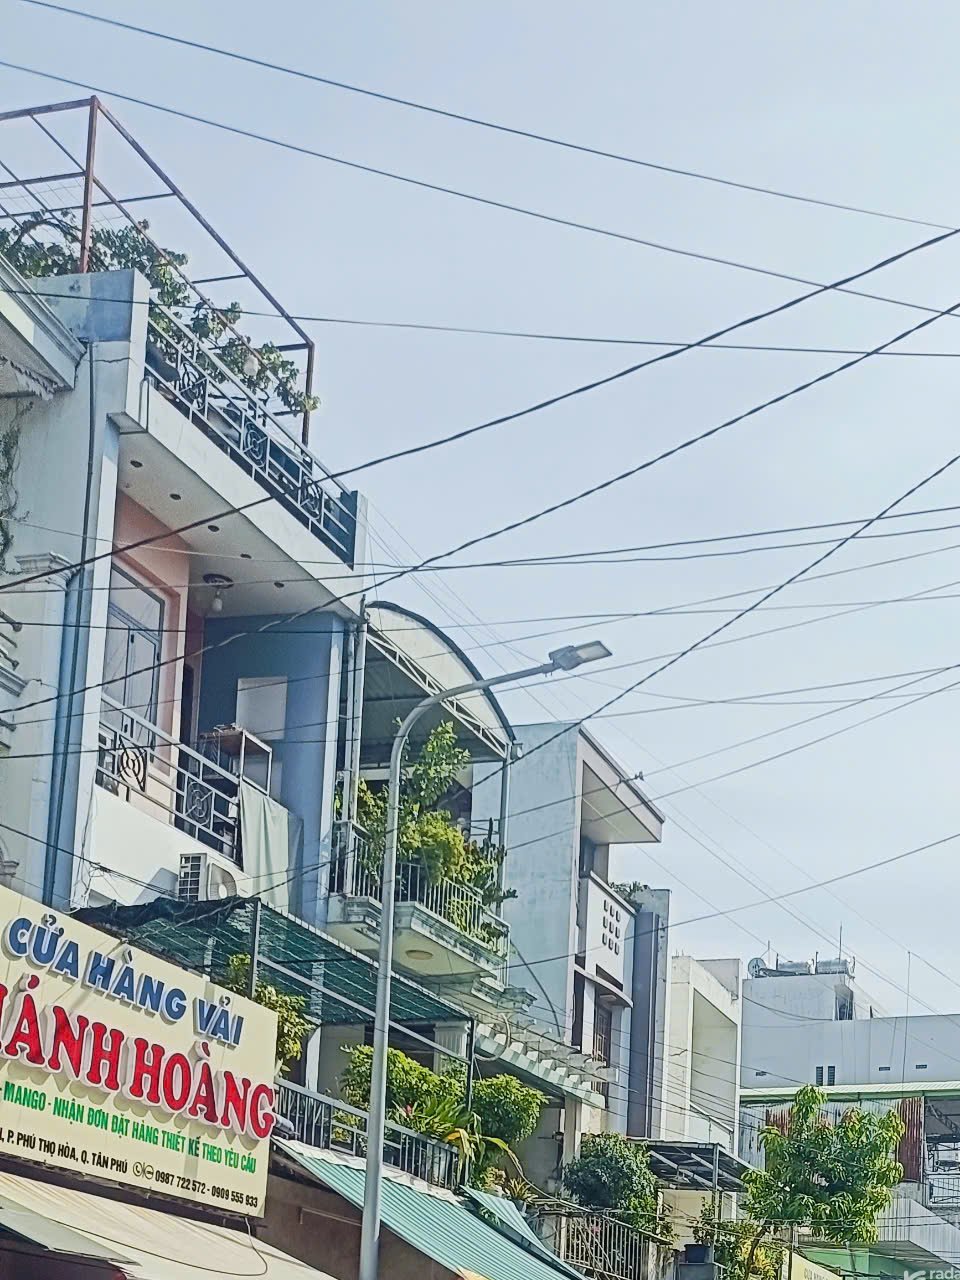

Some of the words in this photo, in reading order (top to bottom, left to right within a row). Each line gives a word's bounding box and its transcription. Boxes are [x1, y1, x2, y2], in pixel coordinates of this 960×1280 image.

[8, 913, 80, 980] CỬA
[87, 949, 187, 1021] HÀNG
[197, 995, 245, 1046] VẢI
[0, 974, 125, 1091] ÁNH
[129, 1037, 275, 1139] HOÀNG
[3, 1080, 47, 1111] MANGO
[52, 1095, 84, 1124] NHẬN
[87, 1107, 110, 1131] ĐƠN
[111, 1112, 130, 1139] ĐẶT
[132, 1119, 158, 1145] HÀNG
[202, 1142, 222, 1164] THEO
[16, 1132, 36, 1149] PHÚ
[38, 1137, 56, 1157] THỌ
[92, 1152, 109, 1168] TÂN
[110, 1157, 128, 1174] PHÚ
[155, 1170, 174, 1186] 0987
[177, 1176, 190, 1191] 722
[191, 1181, 206, 1195] 572
[212, 1185, 229, 1201] 0909
[231, 1191, 244, 1205] 555
[246, 1195, 258, 1209] 933
